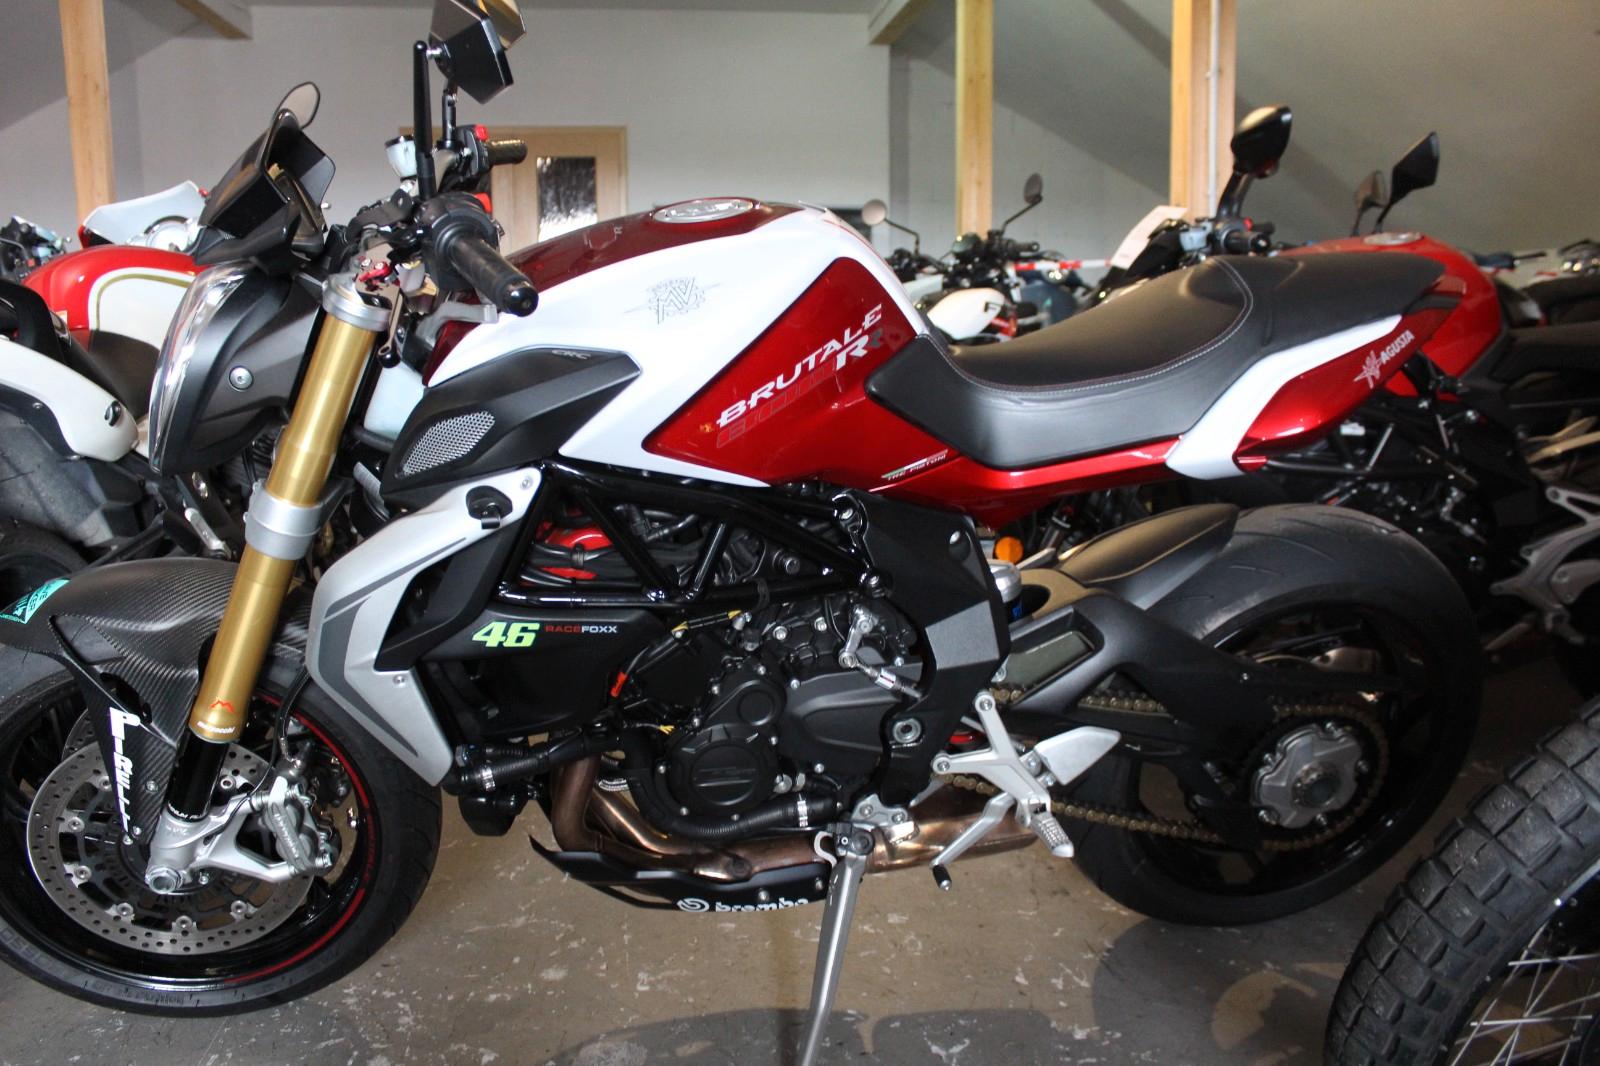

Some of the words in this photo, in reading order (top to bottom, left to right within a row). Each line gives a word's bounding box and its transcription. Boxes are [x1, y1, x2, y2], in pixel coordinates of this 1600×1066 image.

[1380, 329, 1415, 365] AGUSTA
[716, 303, 882, 428] BRUTALE
[472, 621, 540, 648] 46
[545, 624, 618, 634] RACEFOXX
[109, 706, 141, 833] PIRELLI
